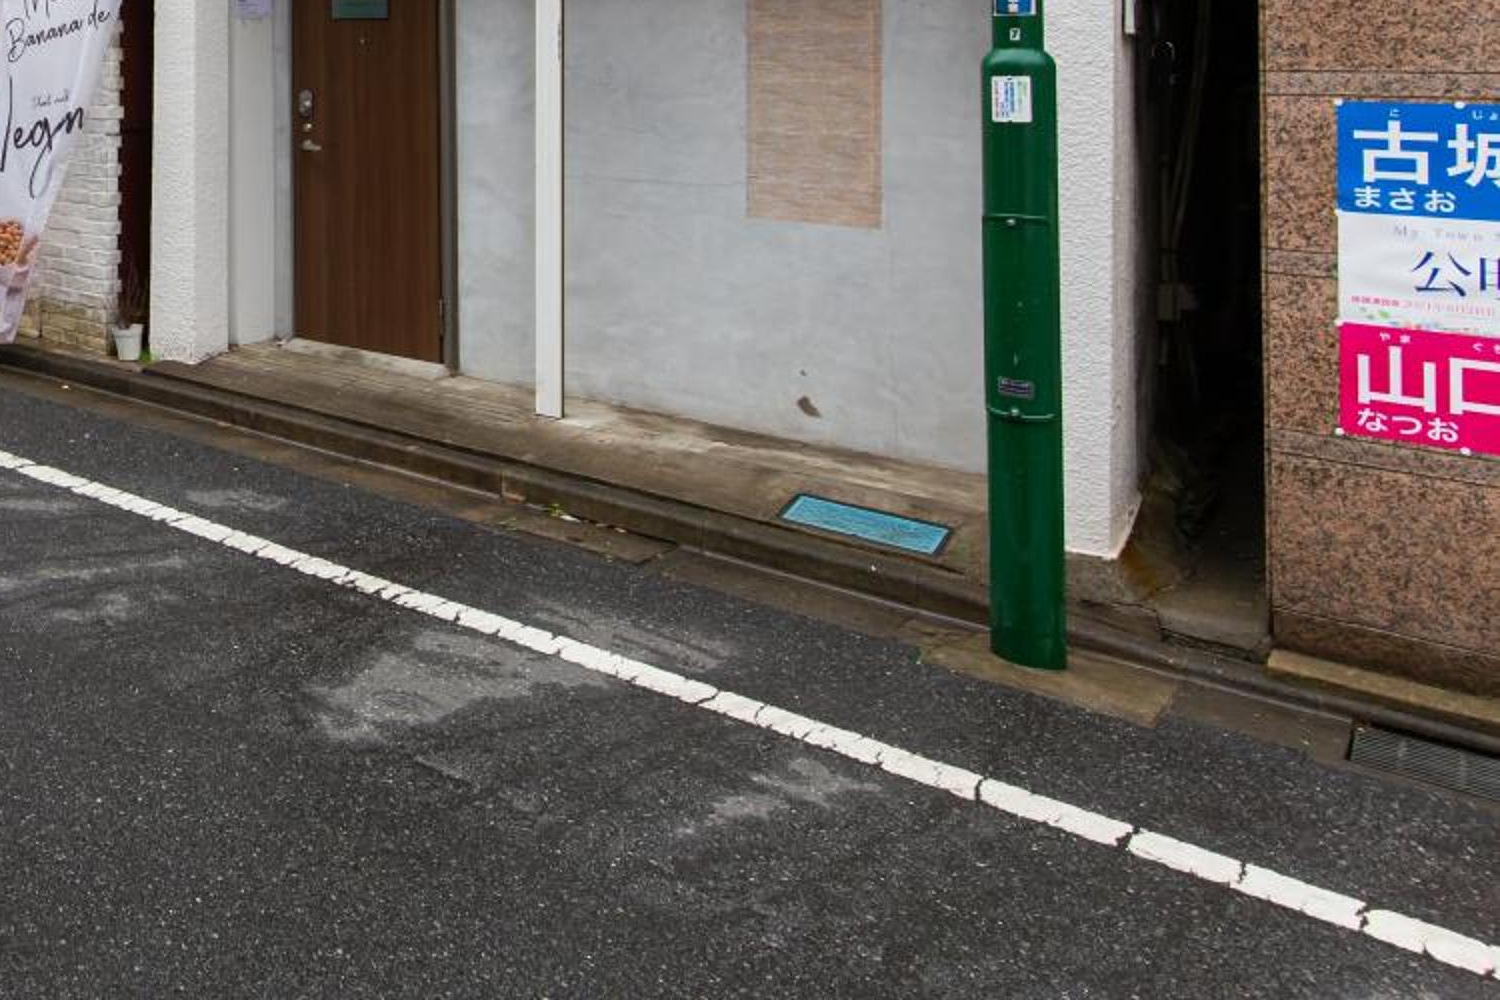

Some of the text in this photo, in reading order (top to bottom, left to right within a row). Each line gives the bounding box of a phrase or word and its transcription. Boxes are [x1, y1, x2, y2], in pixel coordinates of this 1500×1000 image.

[5, 17, 82, 63] Banana
[1389, 107, 1400, 118] に
[1353, 185, 1457, 213] まさお
[1411, 250, 1500, 298] 公
[1357, 407, 1460, 442] なつお
